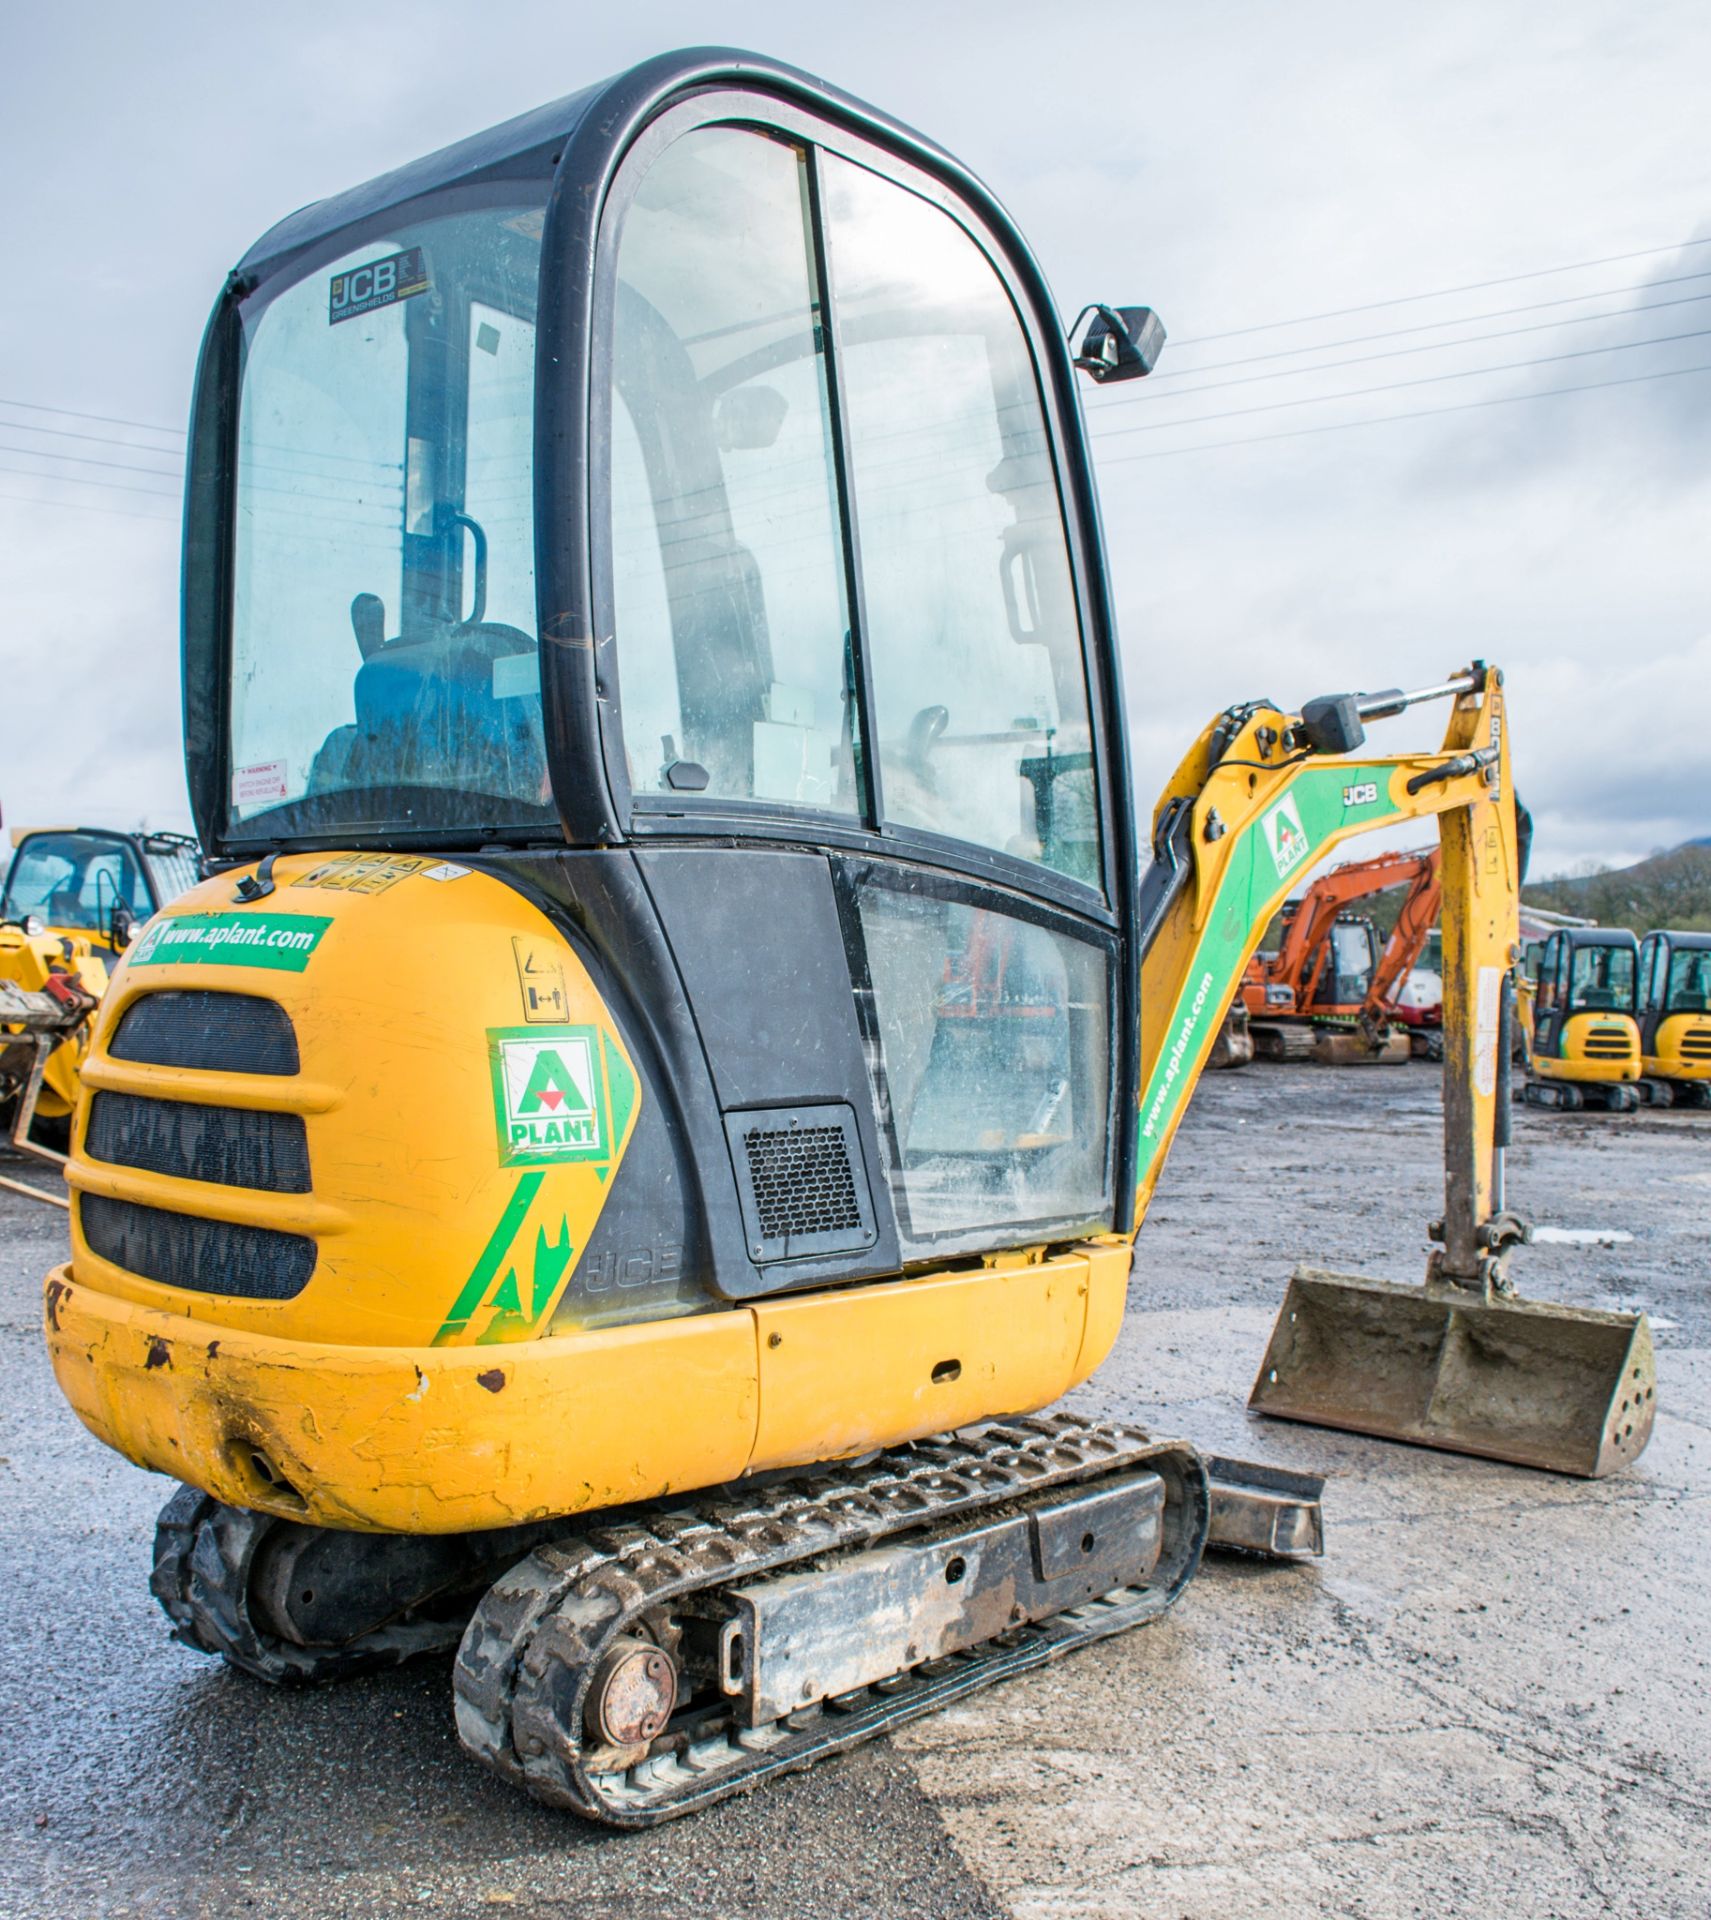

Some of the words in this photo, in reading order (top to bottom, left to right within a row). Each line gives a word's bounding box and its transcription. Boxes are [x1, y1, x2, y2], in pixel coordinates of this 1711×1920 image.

[332, 260, 396, 310] JCB
[332, 293, 396, 320] GREENSHIELDS
[1343, 783, 1378, 807] JCB
[1277, 836, 1306, 871] PLANT
[162, 921, 315, 950] www.aplant.com
[1142, 972, 1214, 1138] www.aplant.com
[517, 1050, 589, 1114] A
[511, 1119, 594, 1146] PLANT
